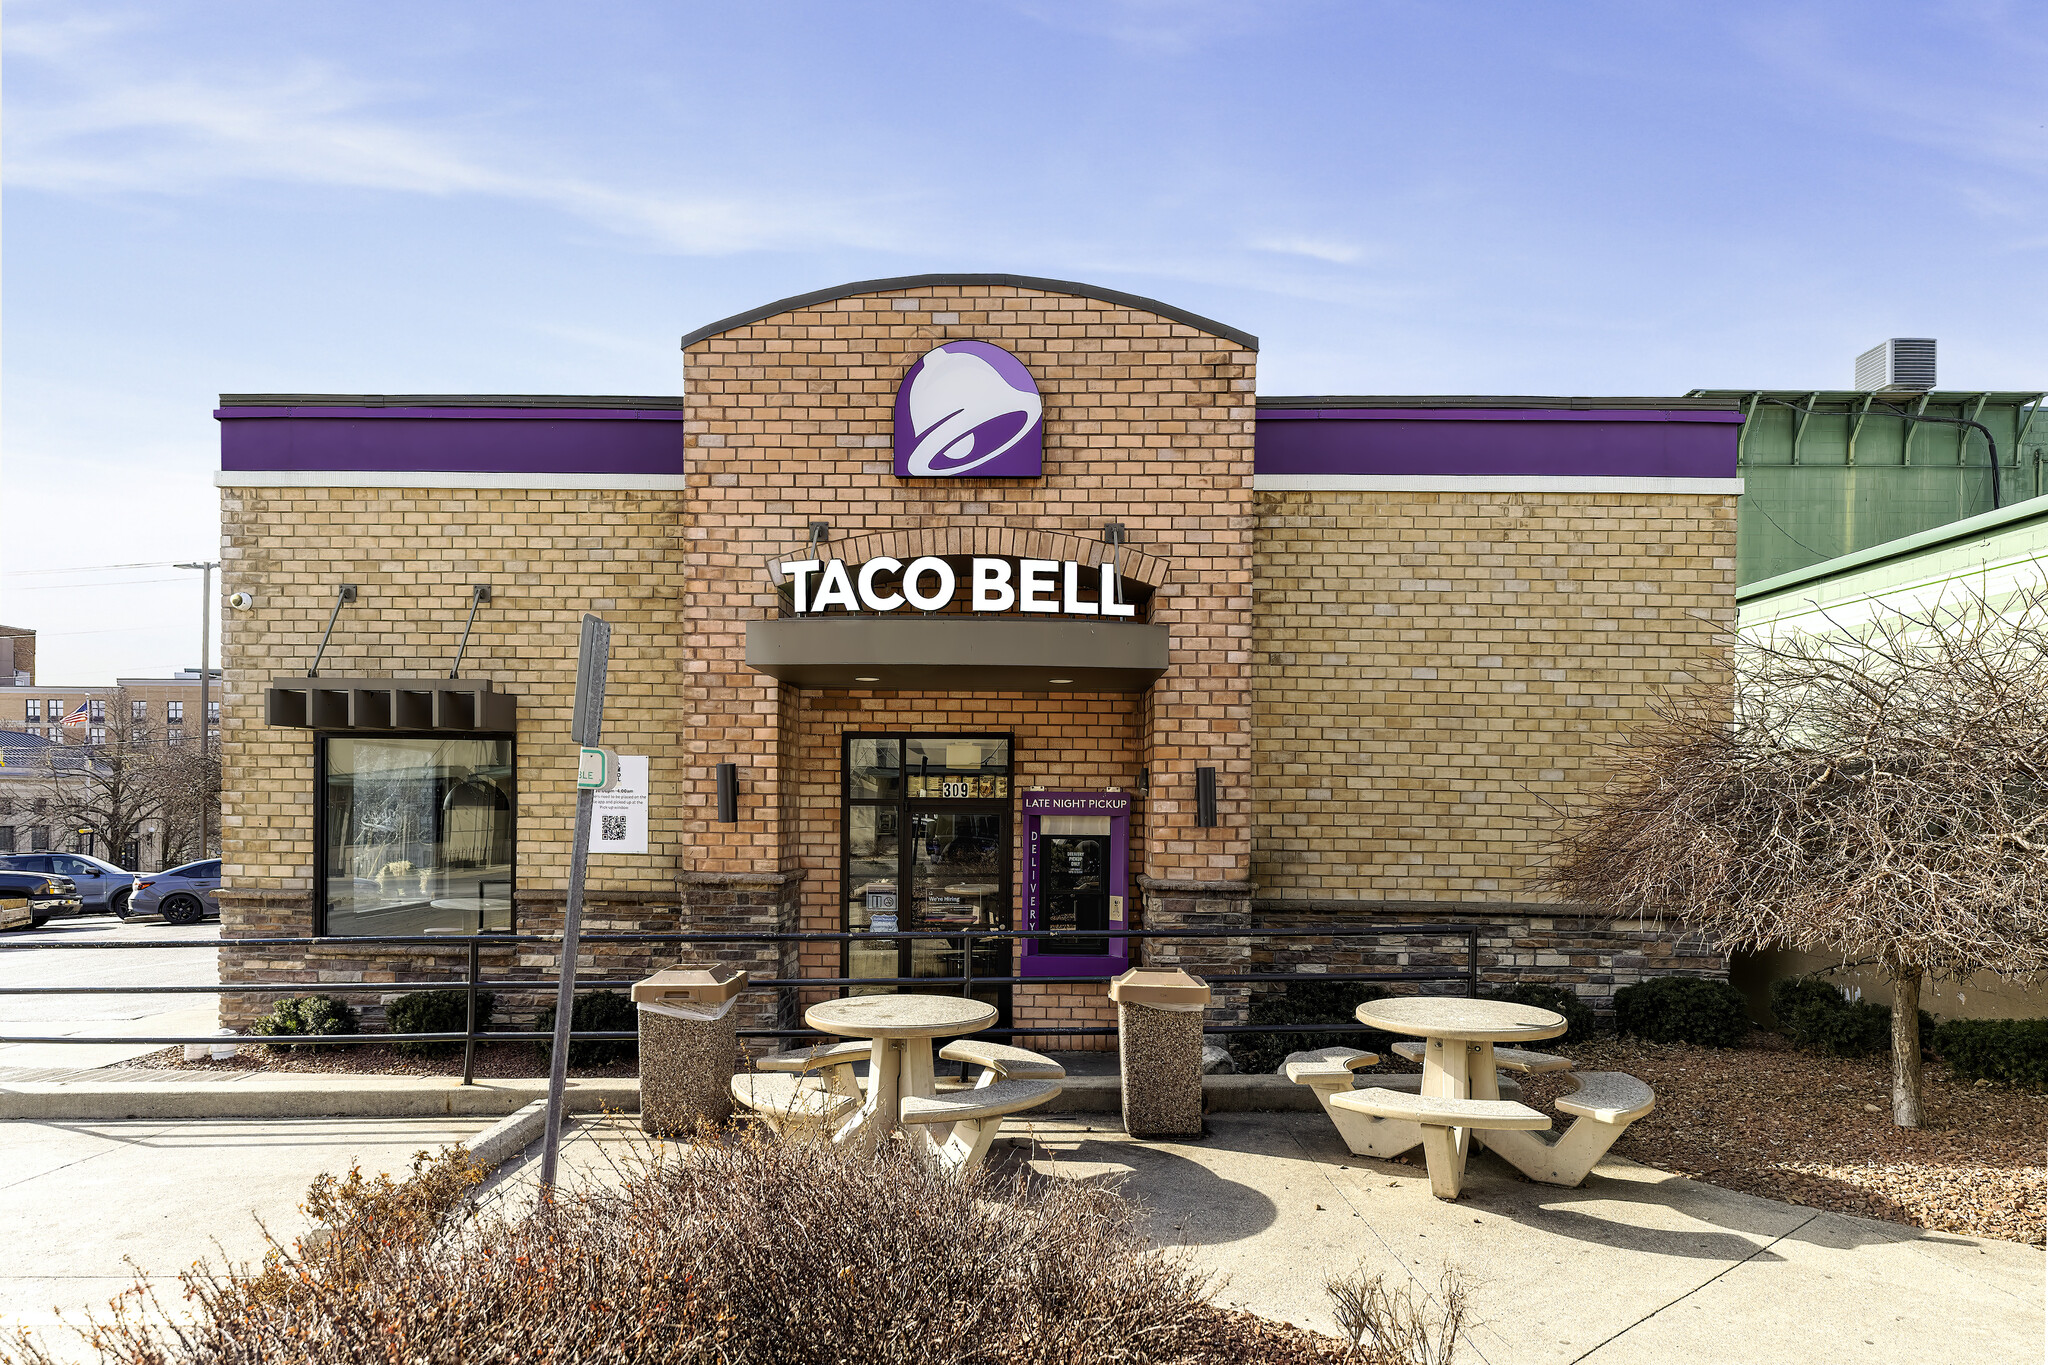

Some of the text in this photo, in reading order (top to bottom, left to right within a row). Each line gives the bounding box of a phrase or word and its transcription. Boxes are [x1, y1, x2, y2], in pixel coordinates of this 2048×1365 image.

[781, 556, 1135, 617] TACO BELL
[944, 783, 968, 797] 309
[1026, 799, 1127, 809] LATE NIGHT PICKUP
[1029, 831, 1038, 931] DELIVERY
